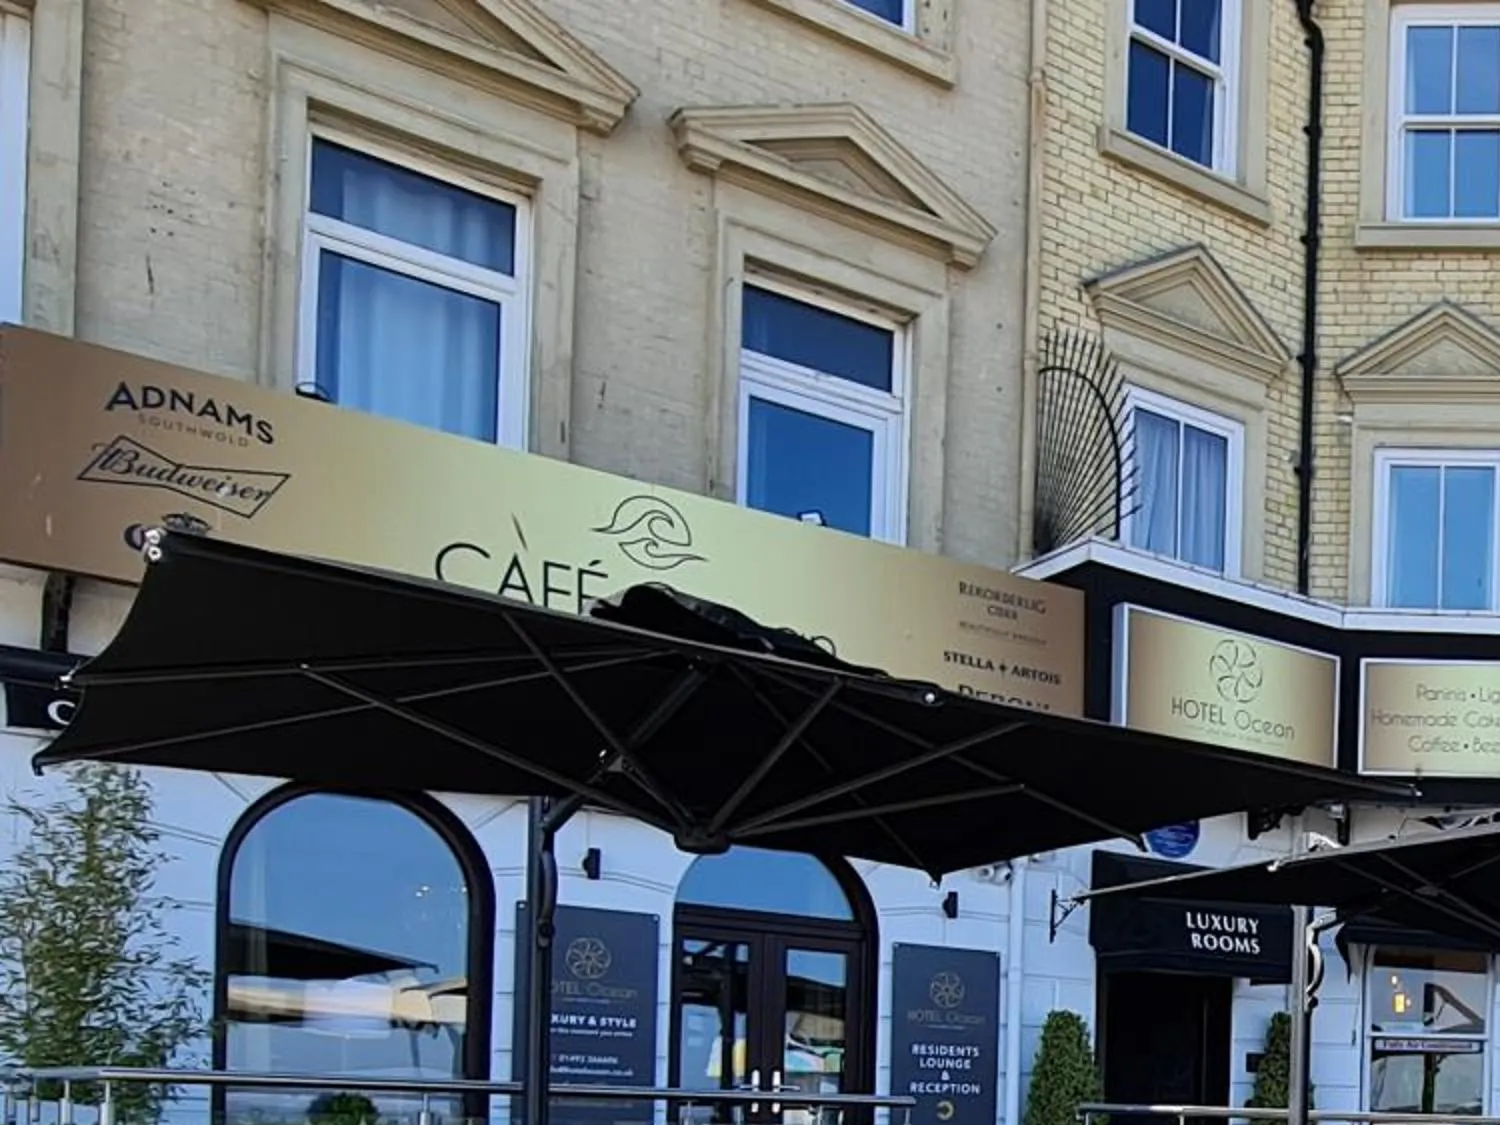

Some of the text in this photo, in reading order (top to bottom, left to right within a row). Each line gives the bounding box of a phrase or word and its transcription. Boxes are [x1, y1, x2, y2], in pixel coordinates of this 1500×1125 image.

[104, 381, 275, 445] ADNAMS
[138, 413, 249, 448] SOUTHWOLD
[92, 442, 273, 502] Budweiser
[943, 650, 1062, 686] STELLA ARTOIS
[1171, 696, 1227, 726] HOTEL
[1234, 709, 1295, 741] Ocean
[1372, 708, 1458, 728] Homemade
[1408, 734, 1460, 753] Coffee
[1186, 911, 1260, 934] LUXURY
[1190, 931, 1261, 955] ROOMS
[551, 1013, 585, 1026] XURY
[600, 1016, 637, 1030] STYLE
[911, 1043, 980, 1057] RESIDENTS
[920, 1058, 971, 1070] LOUNGE
[910, 1082, 981, 1095] RECEPTION
